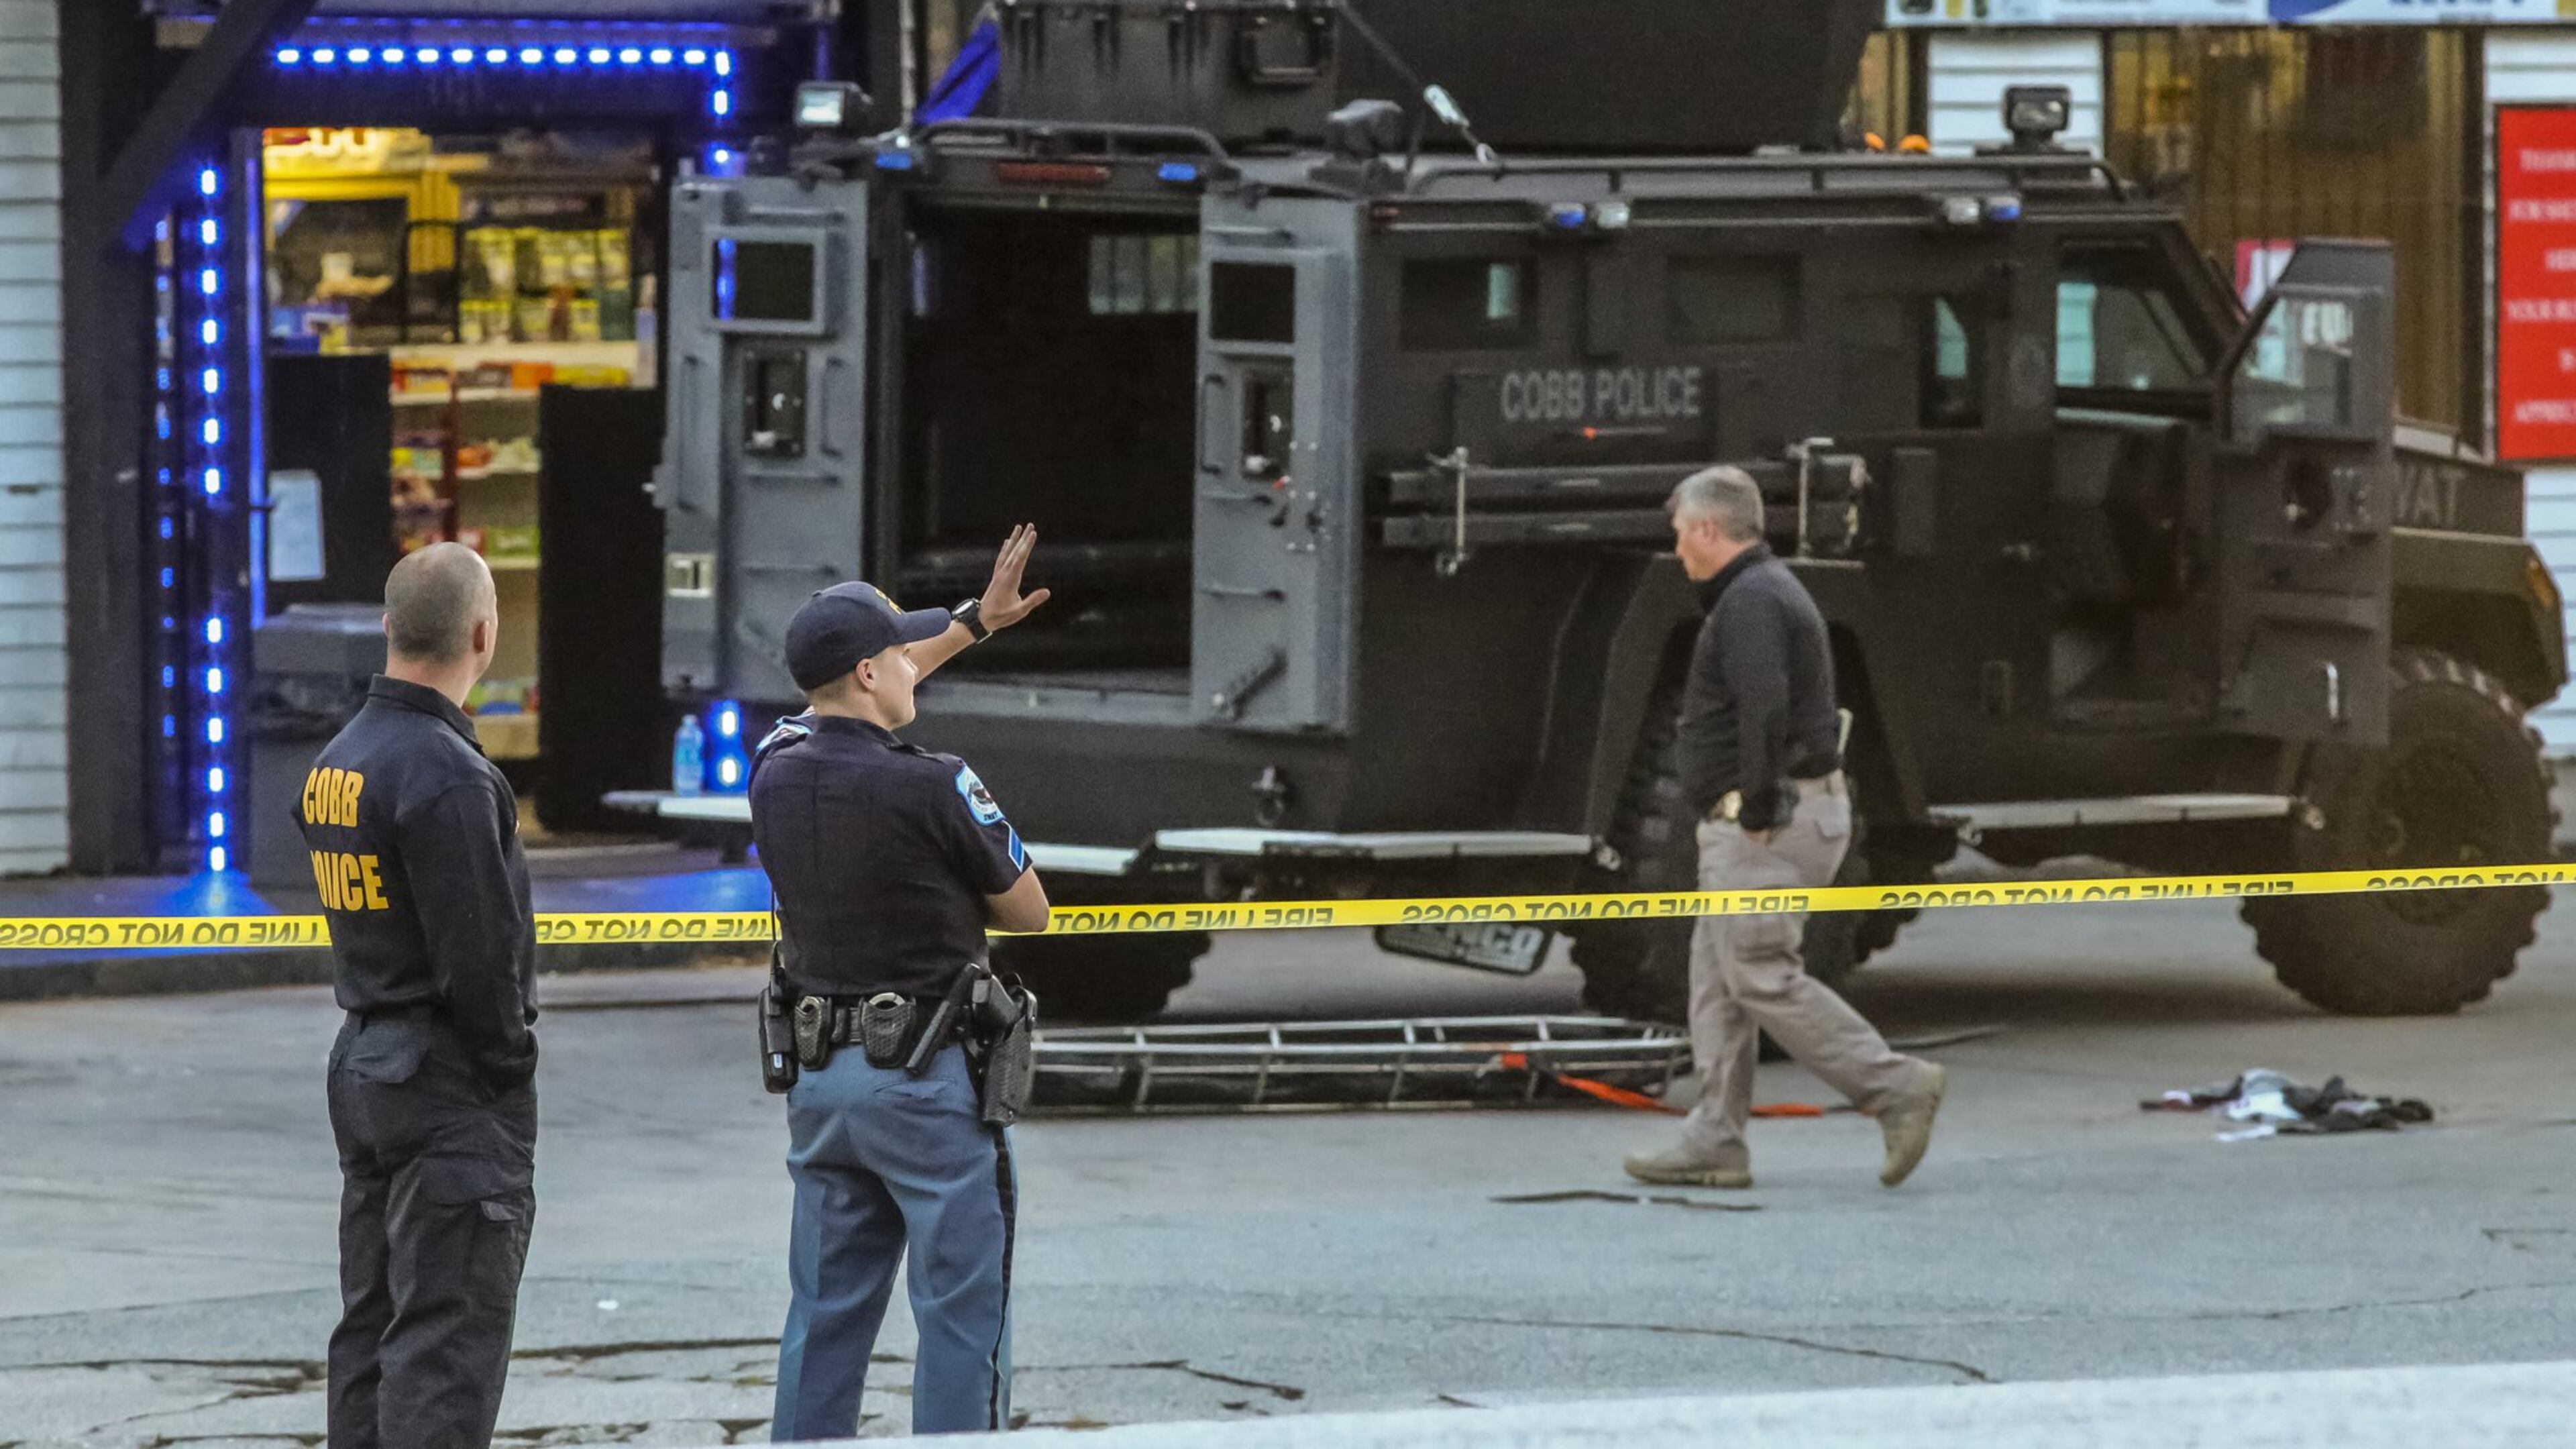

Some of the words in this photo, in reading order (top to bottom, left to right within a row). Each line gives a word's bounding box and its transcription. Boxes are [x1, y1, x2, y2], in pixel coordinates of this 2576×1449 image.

[1501, 370, 1585, 420] COBB
[1595, 366, 1701, 417] POLICE
[303, 767, 364, 827] COBB
[310, 849, 389, 911] OLICE
